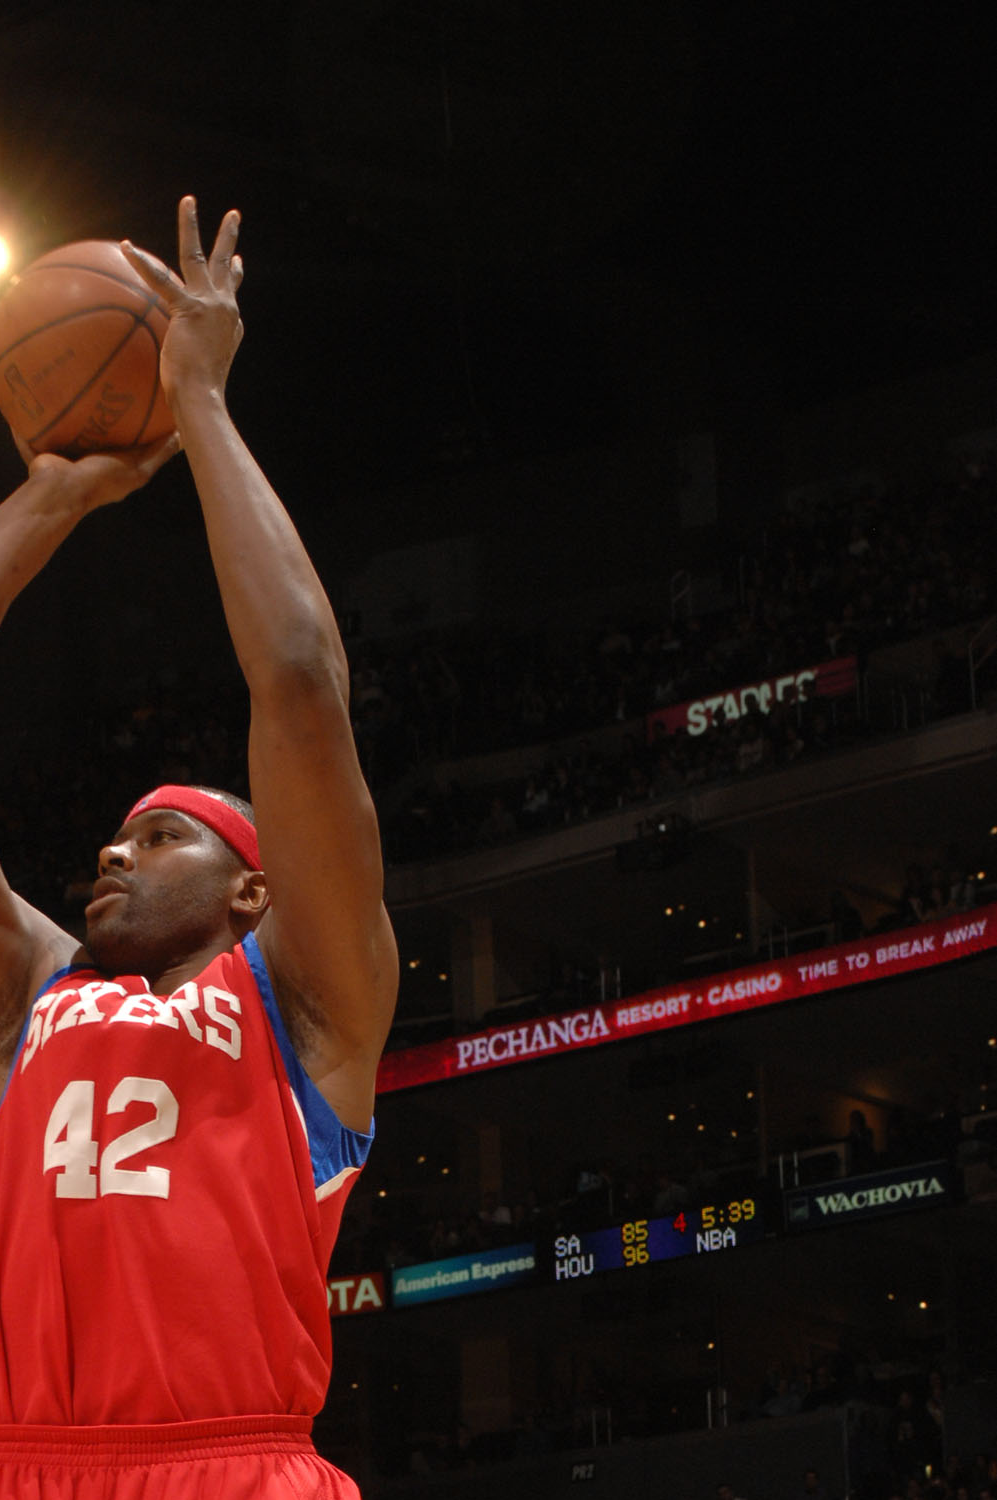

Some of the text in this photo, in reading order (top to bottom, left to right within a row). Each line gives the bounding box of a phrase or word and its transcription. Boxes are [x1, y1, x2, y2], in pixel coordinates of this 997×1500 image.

[457, 919, 988, 1069] PECHANGA RESORT CASINO TIME TO BREAK AWAY
[21, 981, 242, 1074] SIXERS
[43, 1076, 179, 1199] 42
[816, 1178, 944, 1215] WACHOVIA
[555, 1200, 755, 1257] SA 85 4 5:39
[556, 1226, 736, 1280] HOU 96 NBA
[395, 1257, 535, 1294] American Express
